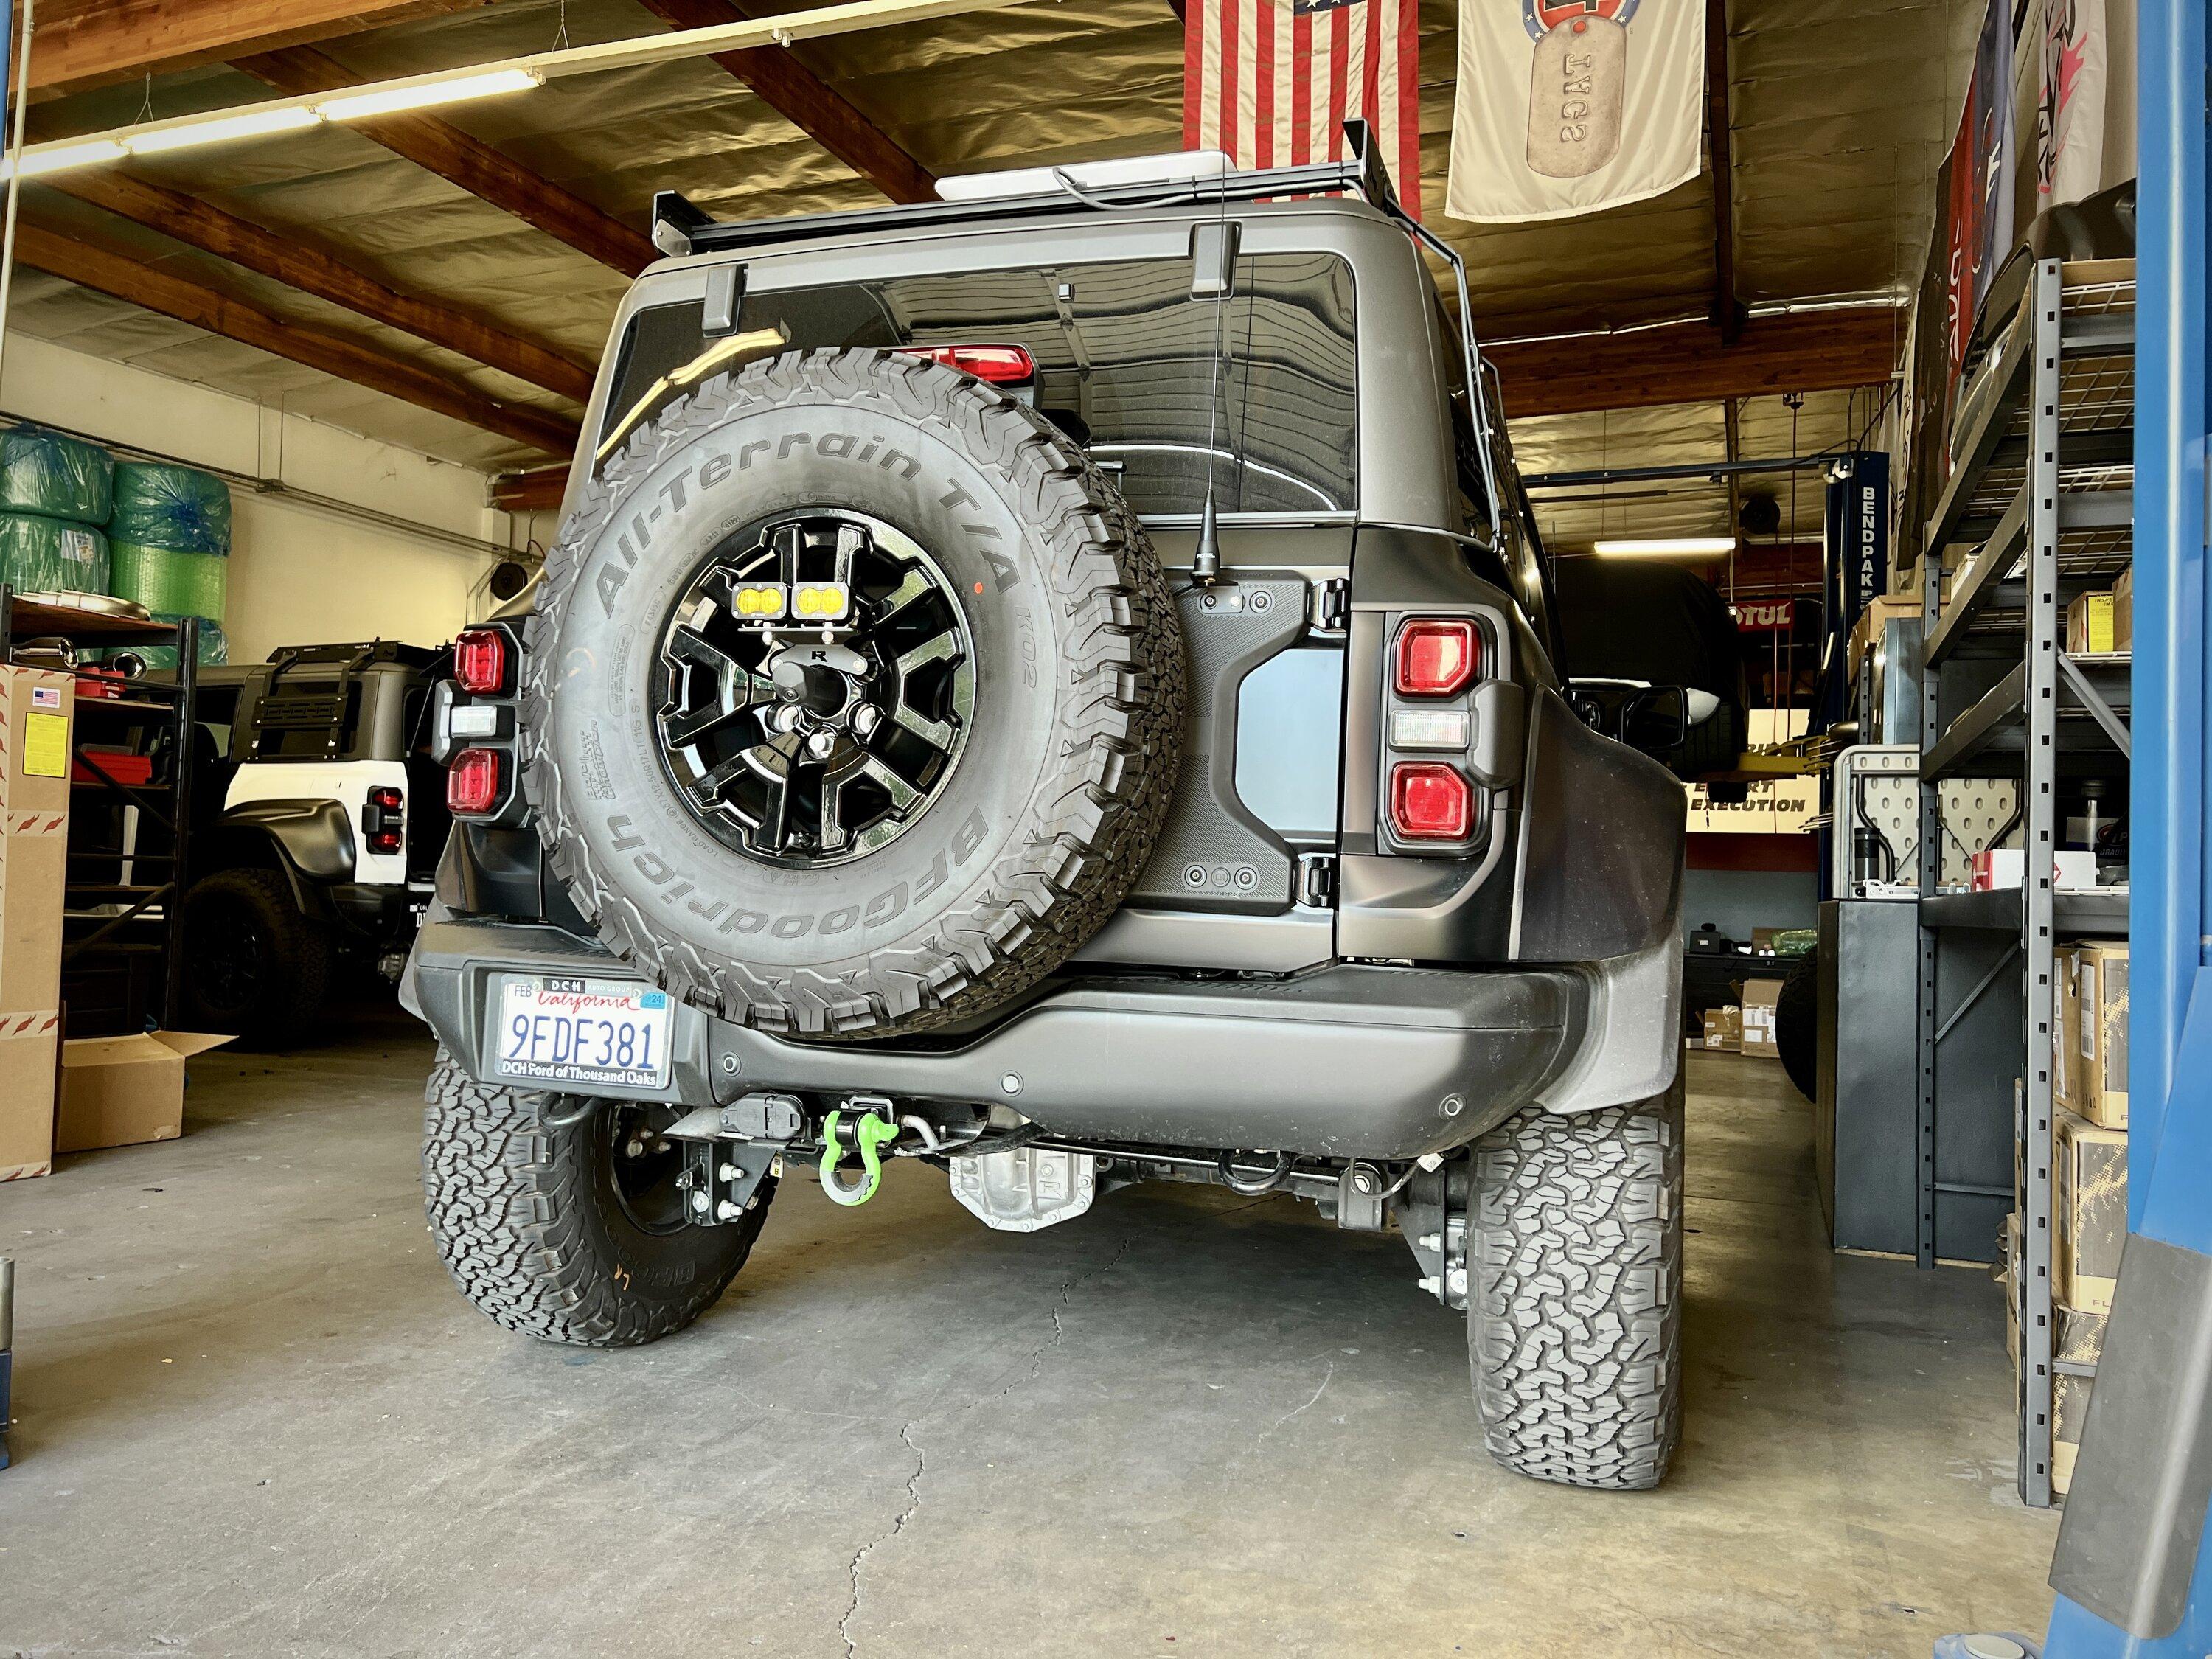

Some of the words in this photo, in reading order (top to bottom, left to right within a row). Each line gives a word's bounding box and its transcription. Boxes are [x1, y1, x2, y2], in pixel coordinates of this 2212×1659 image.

[596, 431, 922, 619] All-Terrain
[1861, 487, 1875, 587] BENDPAK
[607, 803, 990, 939] BFGoodrich
[538, 991, 641, 1014] California
[552, 980, 581, 992] DCH
[587, 984, 607, 992] AUTO
[608, 984, 630, 993] GROUP
[509, 1014, 654, 1069] 9FDF381
[503, 1060, 527, 1074] DCH
[528, 1062, 553, 1077] Ford
[555, 1065, 568, 1079] of
[568, 1066, 626, 1084] Thousand
[627, 1070, 656, 1085] Oaks
